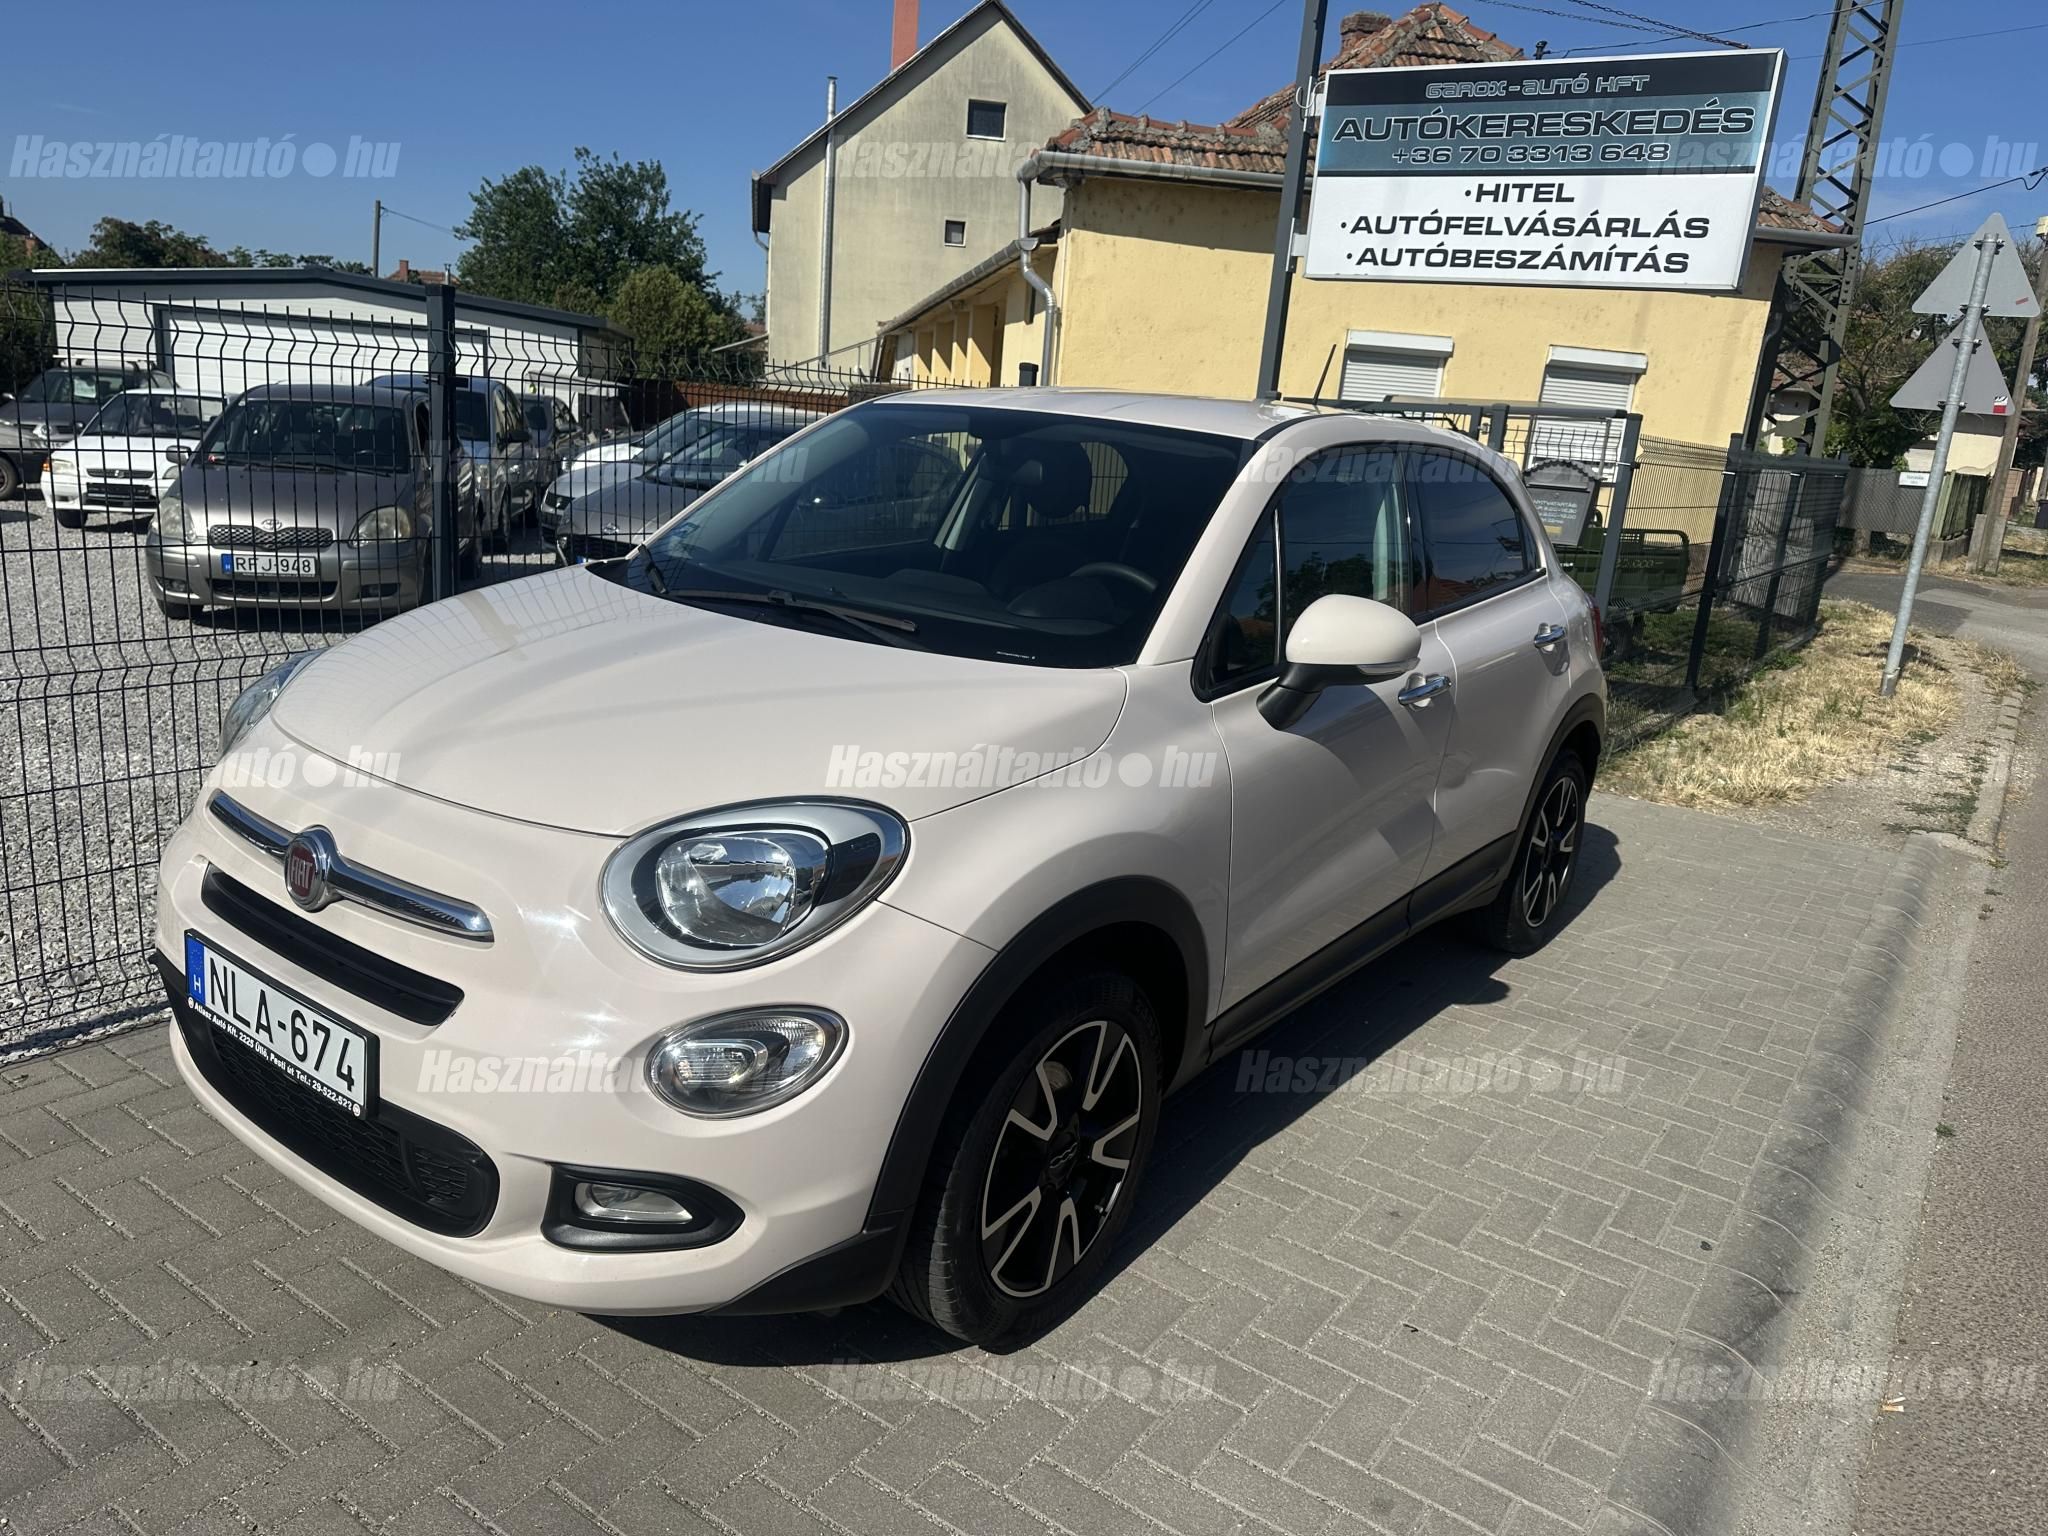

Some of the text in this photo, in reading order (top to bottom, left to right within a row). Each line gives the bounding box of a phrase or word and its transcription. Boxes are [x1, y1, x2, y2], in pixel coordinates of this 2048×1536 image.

[1331, 97, 1755, 143] AUTÓKERESKEDÉS
[1392, 143, 1671, 165] +36 70 3313 648
[1350, 208, 1710, 238] AUTÓFELVÁSÁRLÁS
[1355, 241, 1690, 273] AUTÓBESZÁMÍTÁS
[290, 855, 313, 889] FIAT
[193, 957, 355, 1092] H NLA-674
[212, 1014, 227, 1031] Autó
[227, 1023, 239, 1038] Kft.
[239, 1032, 255, 1048] 2225
[270, 1052, 287, 1071] Pesti
